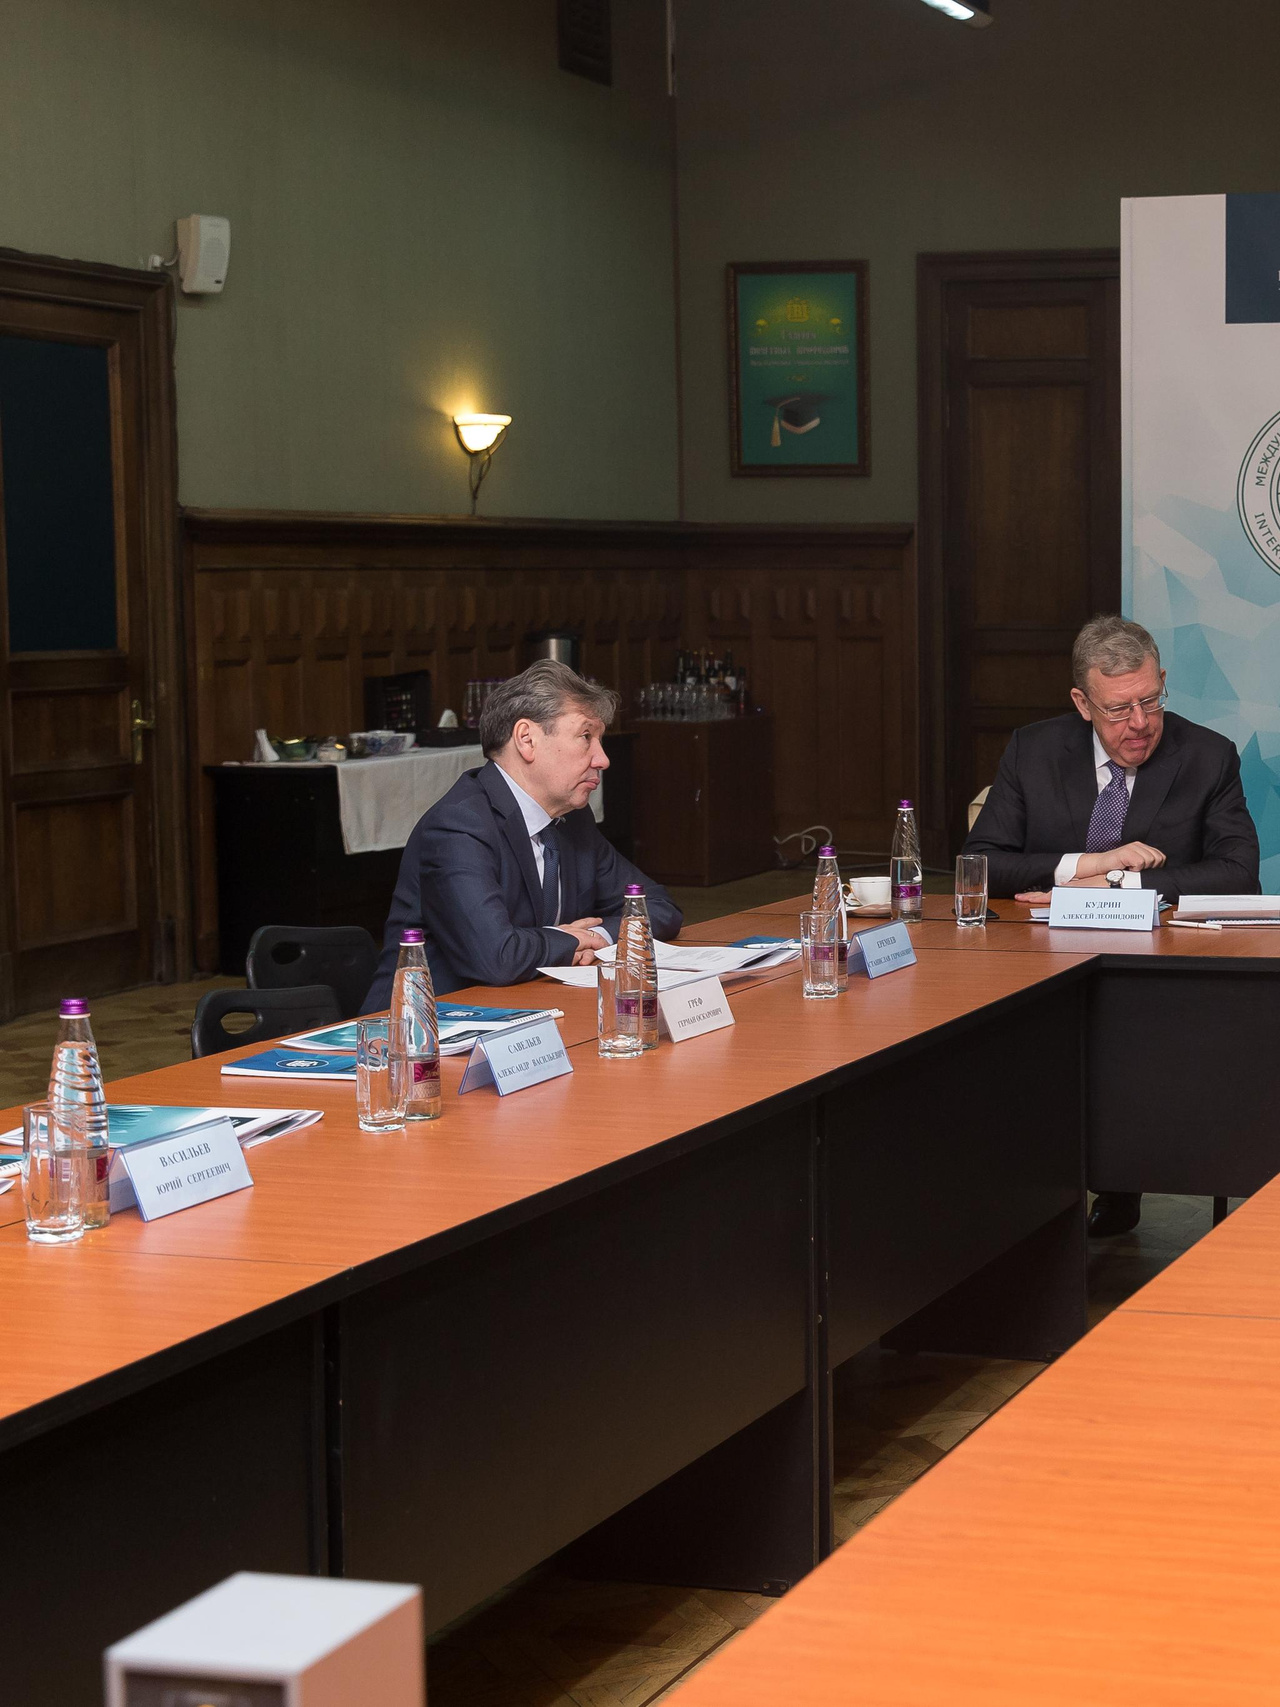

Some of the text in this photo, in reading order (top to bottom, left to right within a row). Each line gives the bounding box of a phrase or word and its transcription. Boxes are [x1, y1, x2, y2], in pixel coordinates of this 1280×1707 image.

[1085, 901, 1121, 909] КУДРИН
[687, 997, 704, 1009] ГРЕФ
[507, 1035, 542, 1055] САВЕЛЬЕВ
[497, 1061, 530, 1079] АЛЕКСАНДР
[159, 1142, 211, 1168] ВАСИЛЬЕВ
[156, 1162, 232, 1196] ЮРИЙ СЕРГЕЕВИЧ
